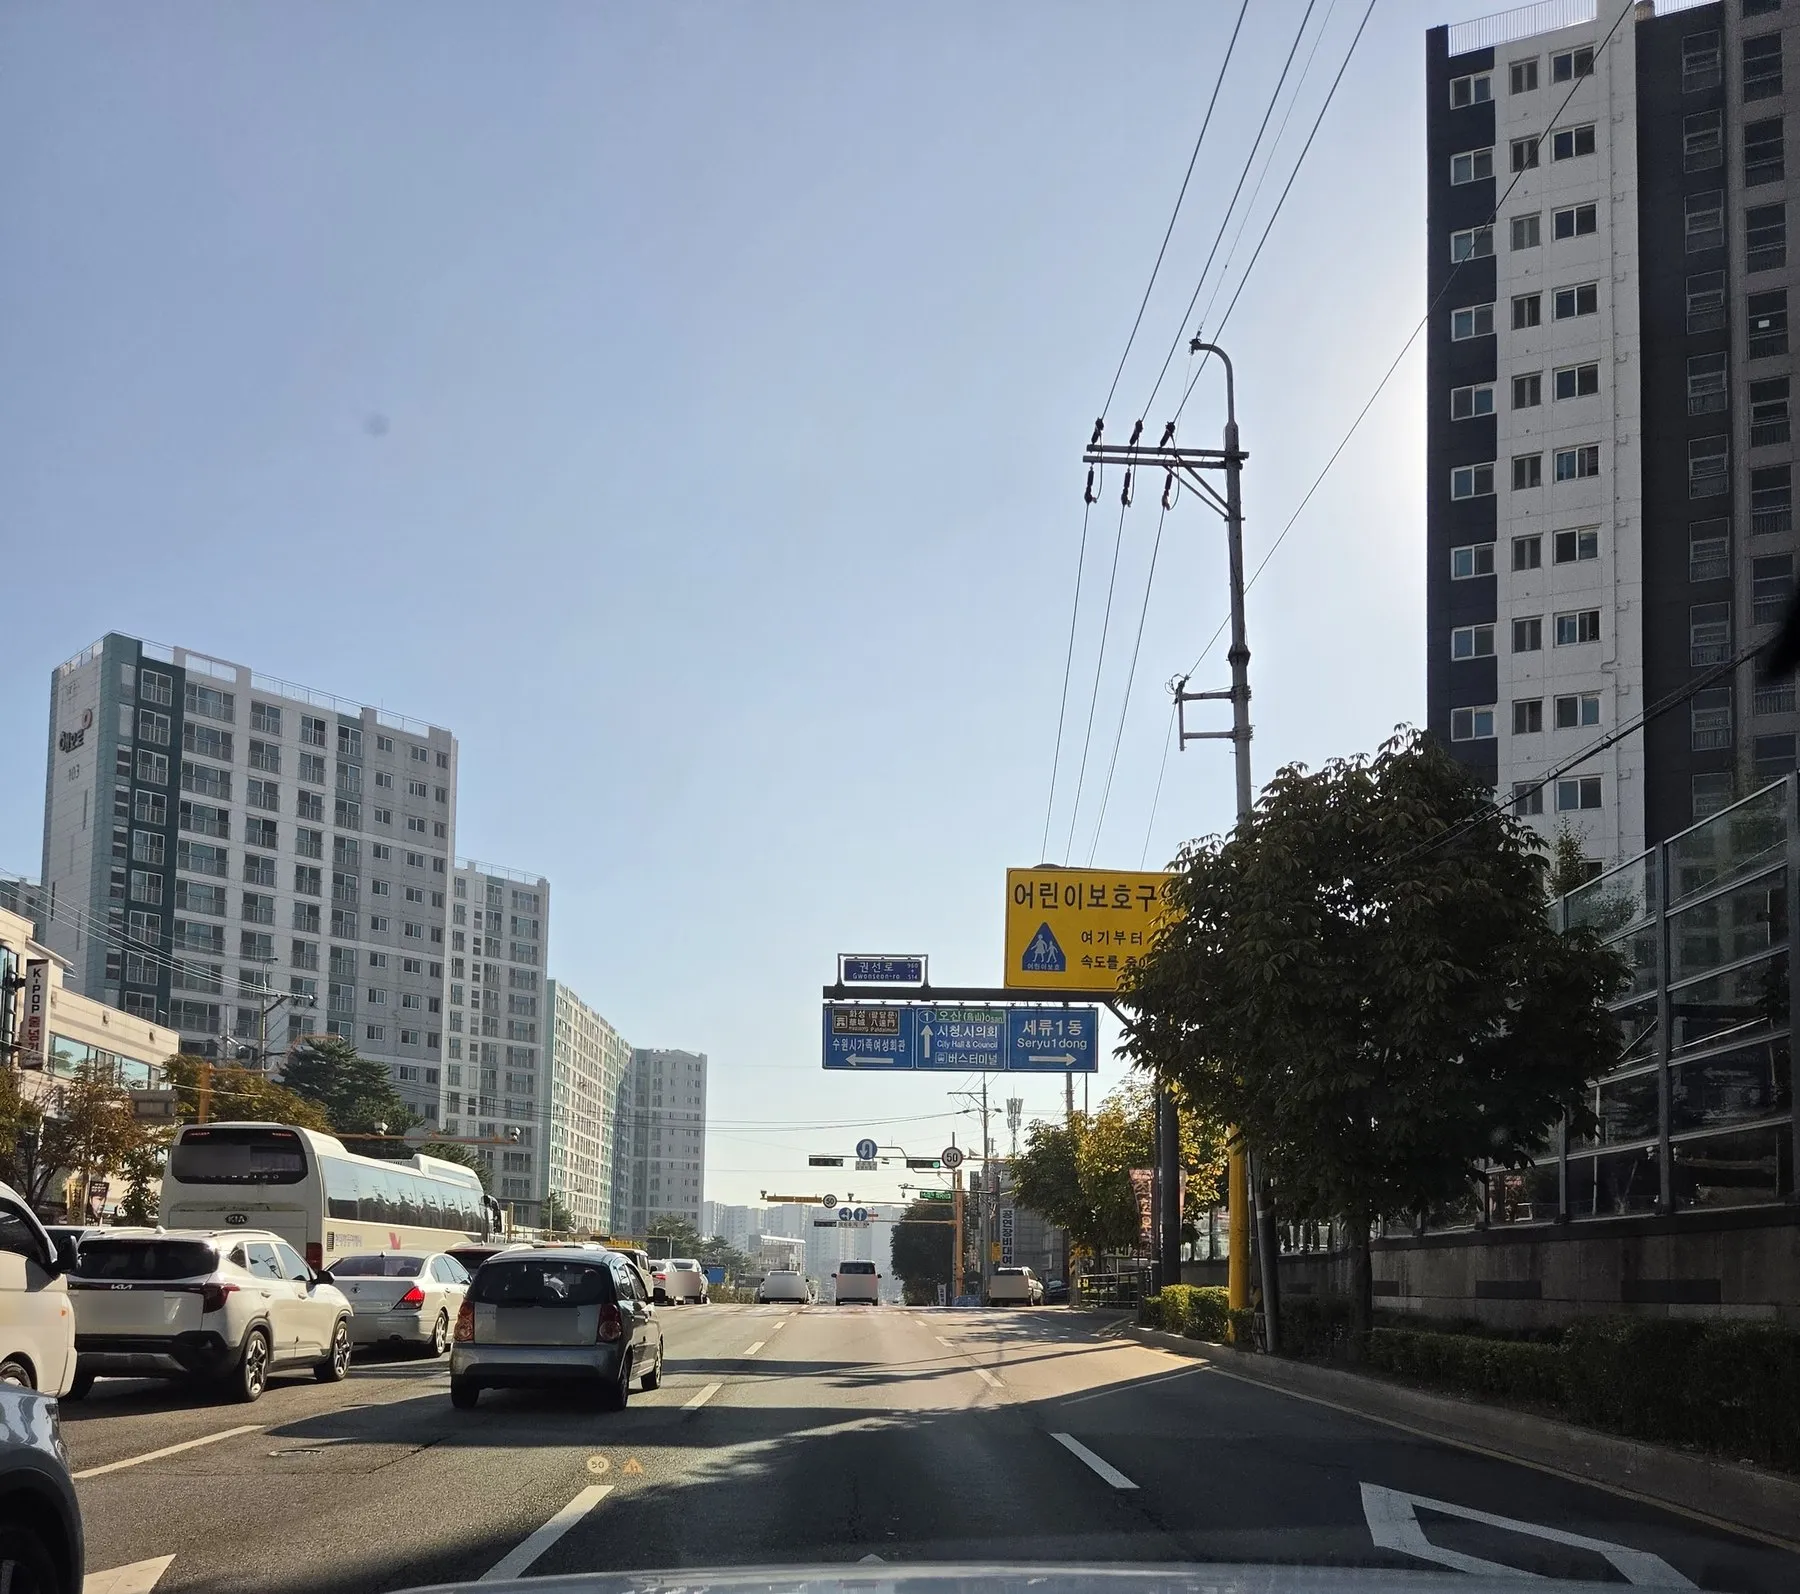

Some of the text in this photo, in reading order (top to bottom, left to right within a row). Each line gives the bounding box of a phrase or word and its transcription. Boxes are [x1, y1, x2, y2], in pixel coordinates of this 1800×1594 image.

[1081, 930, 1143, 945] 여기부터
[860, 962, 894, 973] 권선로
[1081, 954, 1119, 970] 속도를
[31, 968, 42, 1014] K-POP
[924, 1012, 929, 1022] 1
[1022, 1019, 1083, 1036] 세류1동
[832, 1038, 906, 1053] 수원시가족여성회관
[936, 1040, 998, 1049] City Hall & Council
[948, 1052, 998, 1065] 버스터미널
[946, 1153, 958, 1163] 50
[826, 1197, 835, 1205] 50
[227, 1215, 245, 1223] KIA
[1002, 1209, 1014, 1265] 공연장비대여
